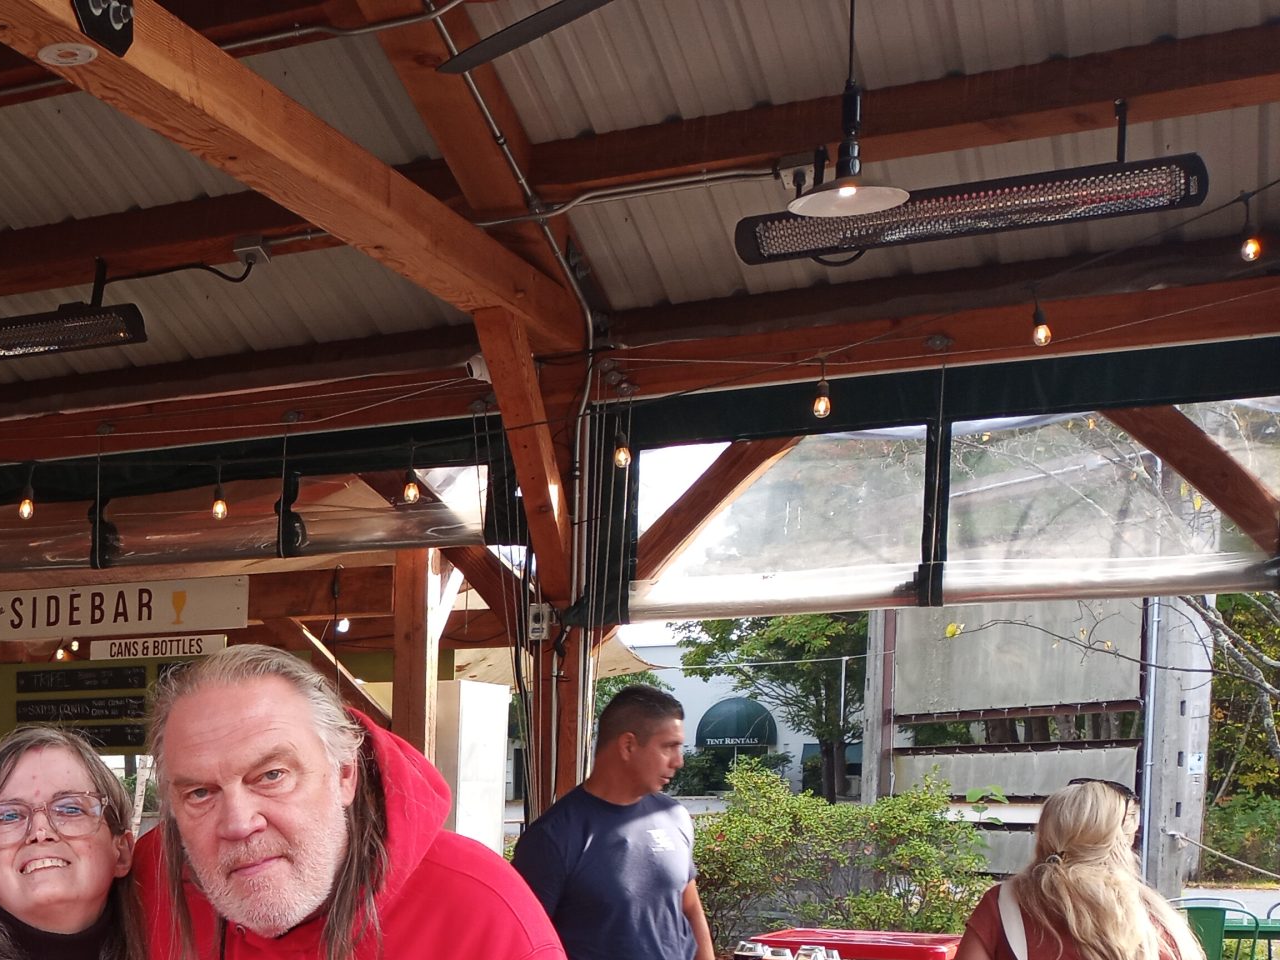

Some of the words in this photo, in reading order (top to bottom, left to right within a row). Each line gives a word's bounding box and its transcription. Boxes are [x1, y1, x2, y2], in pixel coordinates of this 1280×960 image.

[10, 587, 153, 630] SIDEBAR
[110, 641, 139, 657] CANS
[141, 640, 150, 656] &
[152, 638, 203, 656] BOTTLES
